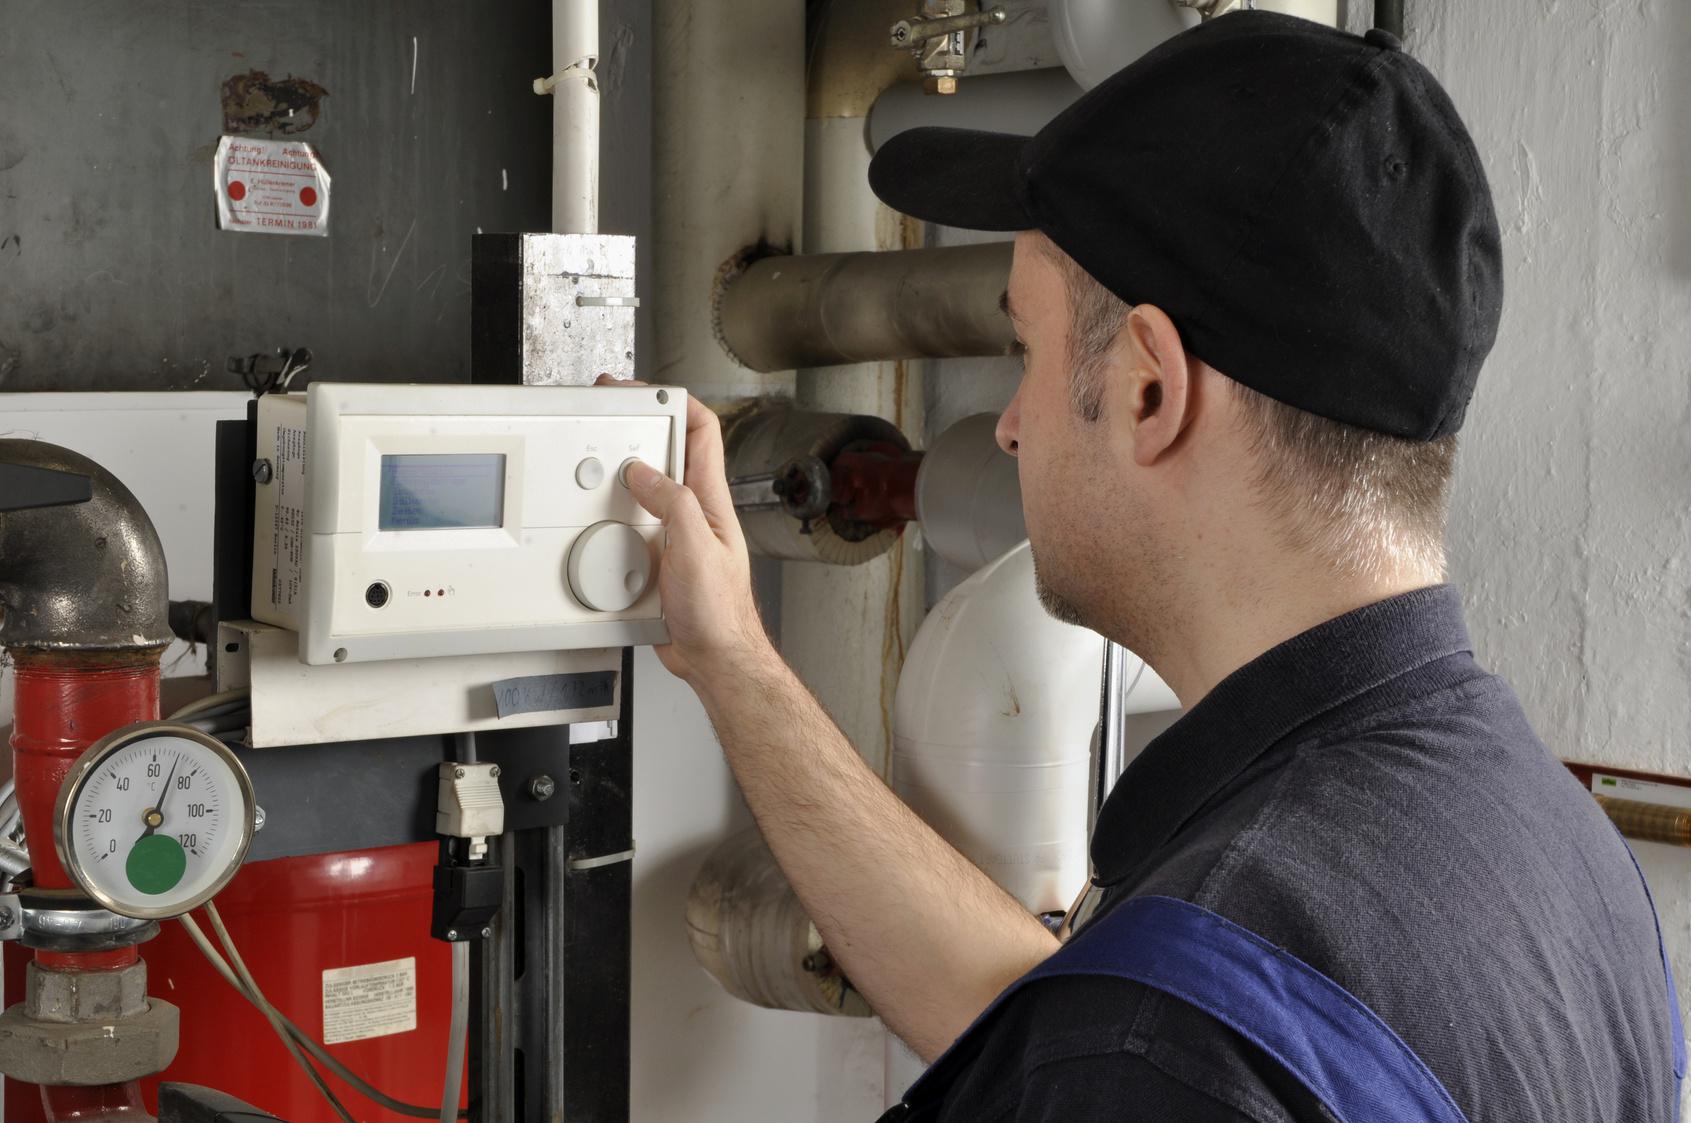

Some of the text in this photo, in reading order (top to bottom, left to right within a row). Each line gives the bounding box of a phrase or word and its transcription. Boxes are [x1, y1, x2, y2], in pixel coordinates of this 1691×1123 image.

[256, 217, 294, 229] TERMIN
[147, 763, 160, 777] 60
[116, 777, 129, 791] 40
[177, 776, 191, 789] 80
[98, 809, 112, 823] 20
[187, 804, 205, 817] 100
[109, 839, 116, 853] 0
[179, 834, 197, 848] 120
